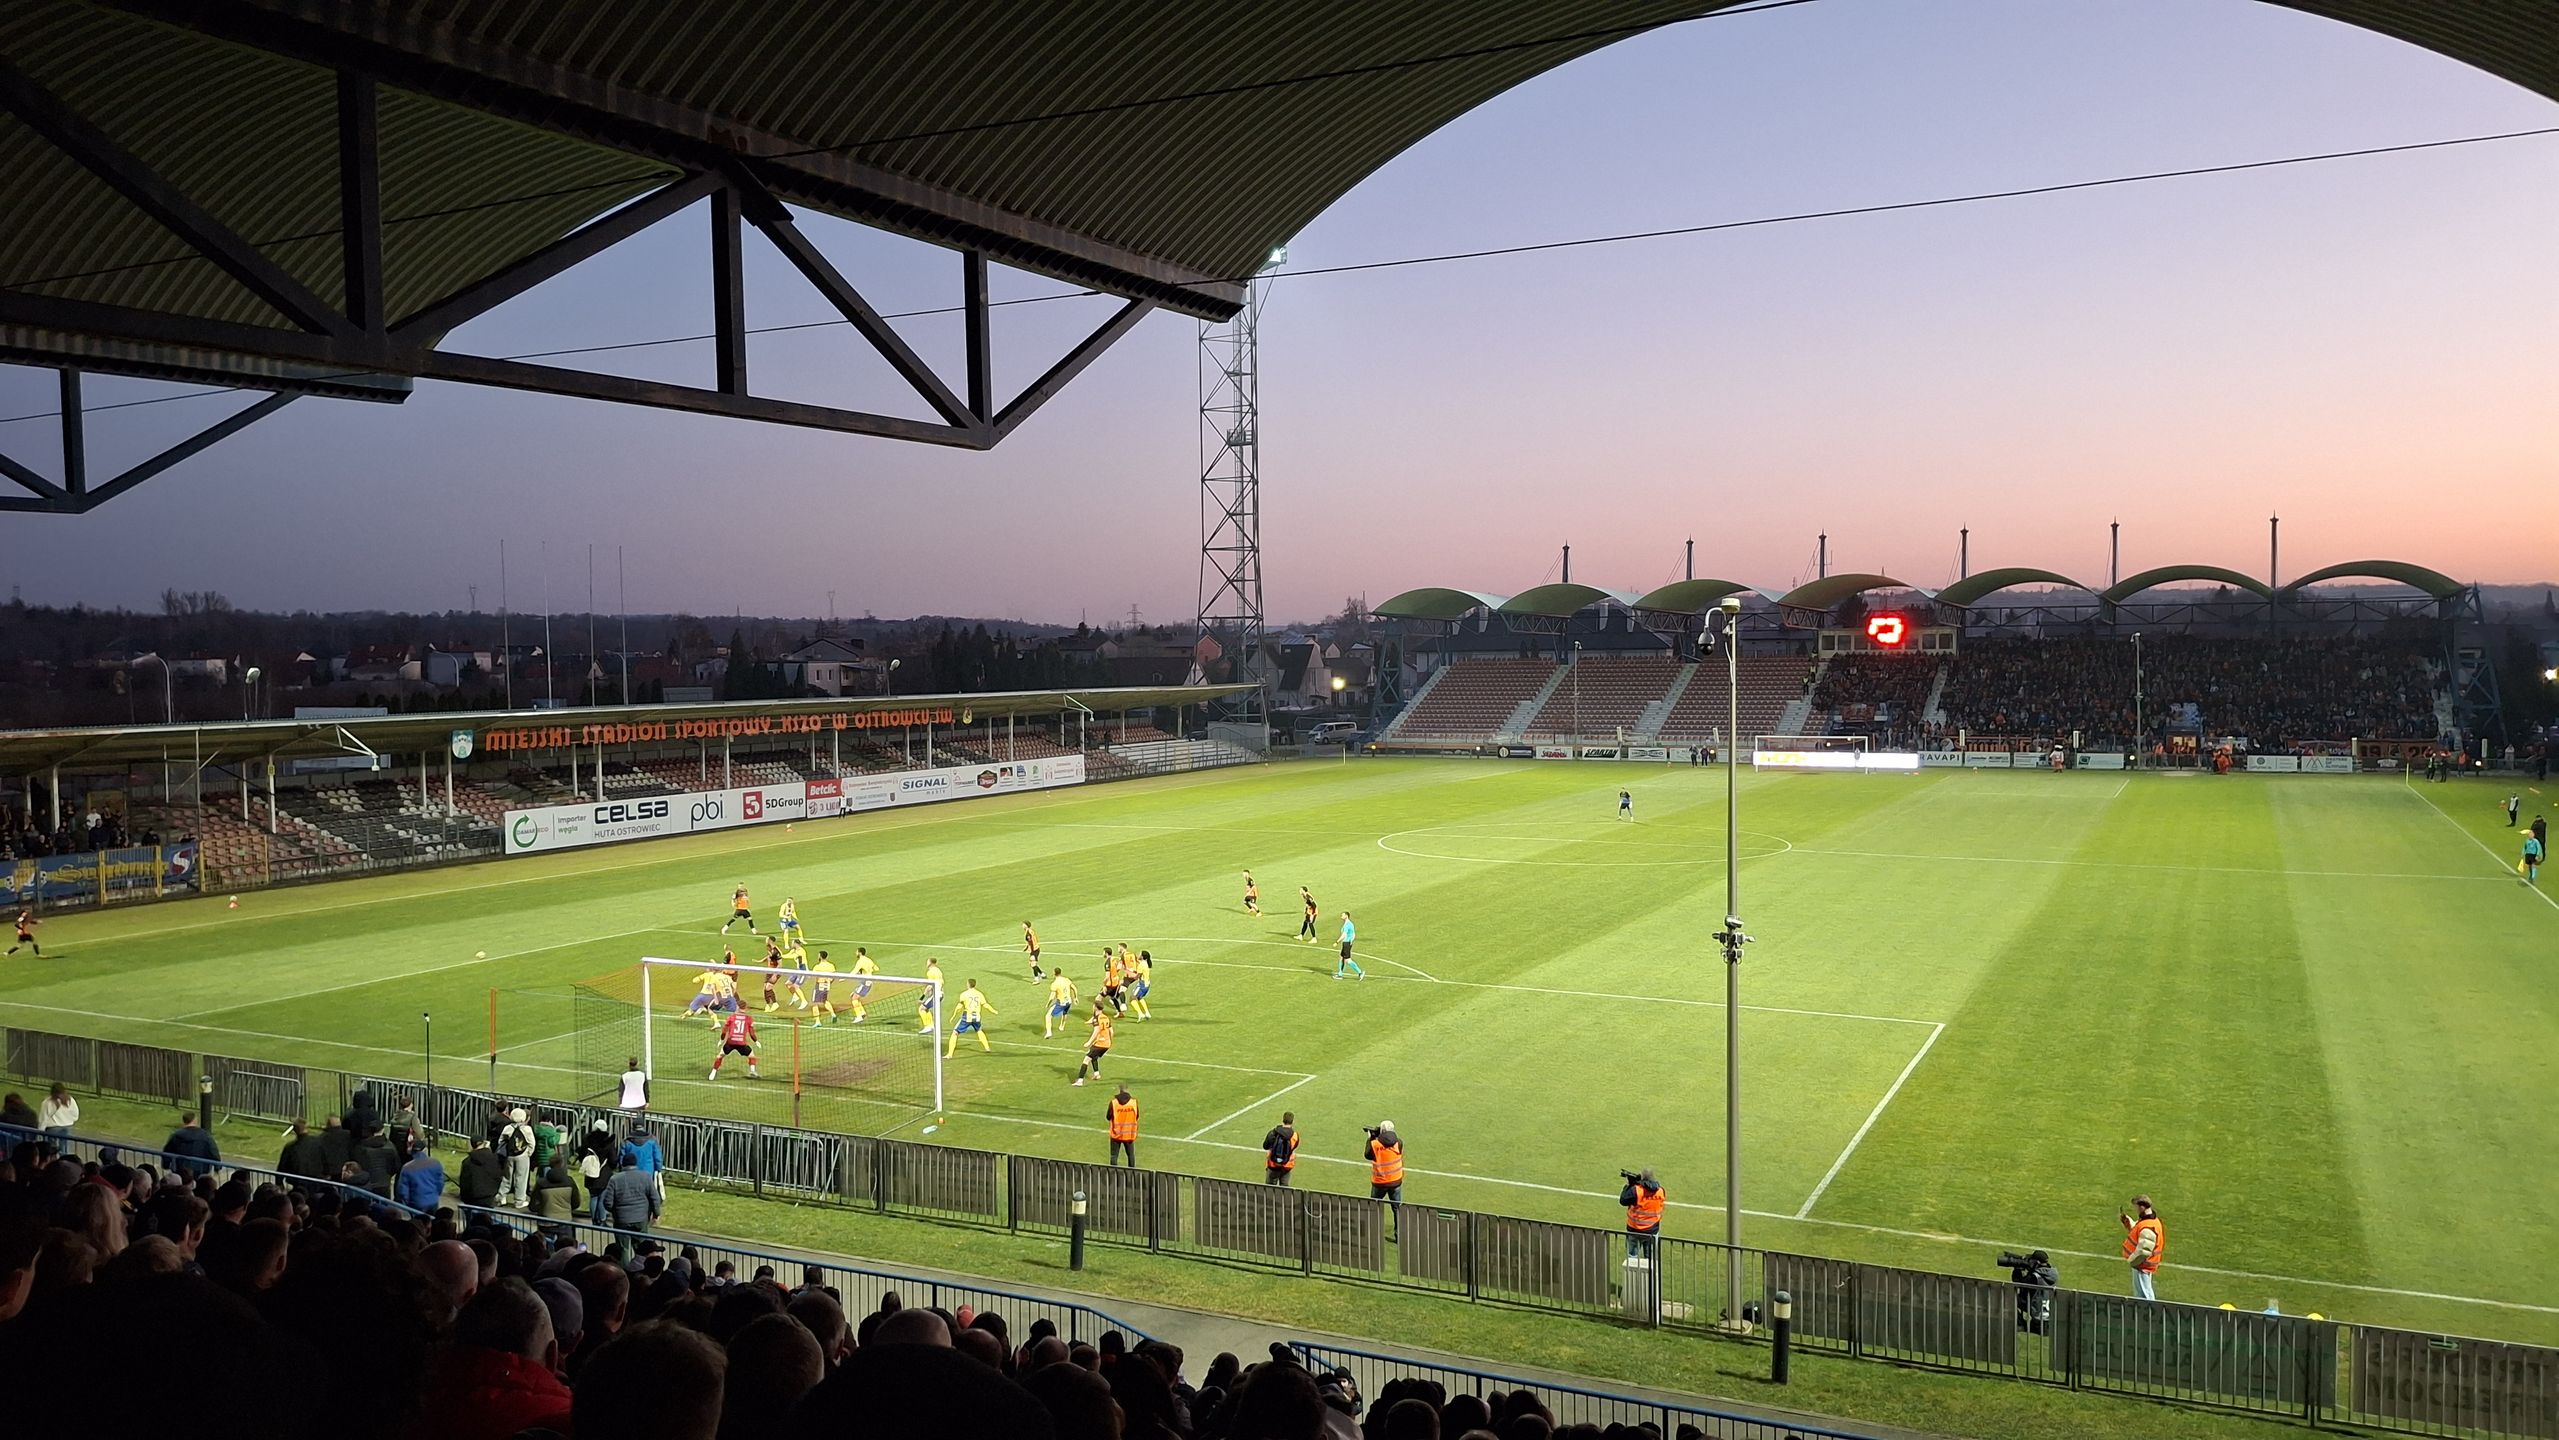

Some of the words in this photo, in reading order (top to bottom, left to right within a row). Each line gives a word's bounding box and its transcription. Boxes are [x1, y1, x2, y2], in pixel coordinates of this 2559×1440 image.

[486, 727, 571, 751] MIEJSKI
[582, 721, 666, 745] STADION
[675, 715, 771, 739] SPORTOWY
[832, 712, 848, 730] W
[809, 783, 837, 796] Betclic
[902, 777, 948, 790] SIGNAL
[765, 797, 804, 809] 5DGroup
[594, 829, 616, 839] HUTA
[616, 823, 661, 836] OSTROWIEC
[733, 1020, 746, 1034] 31
